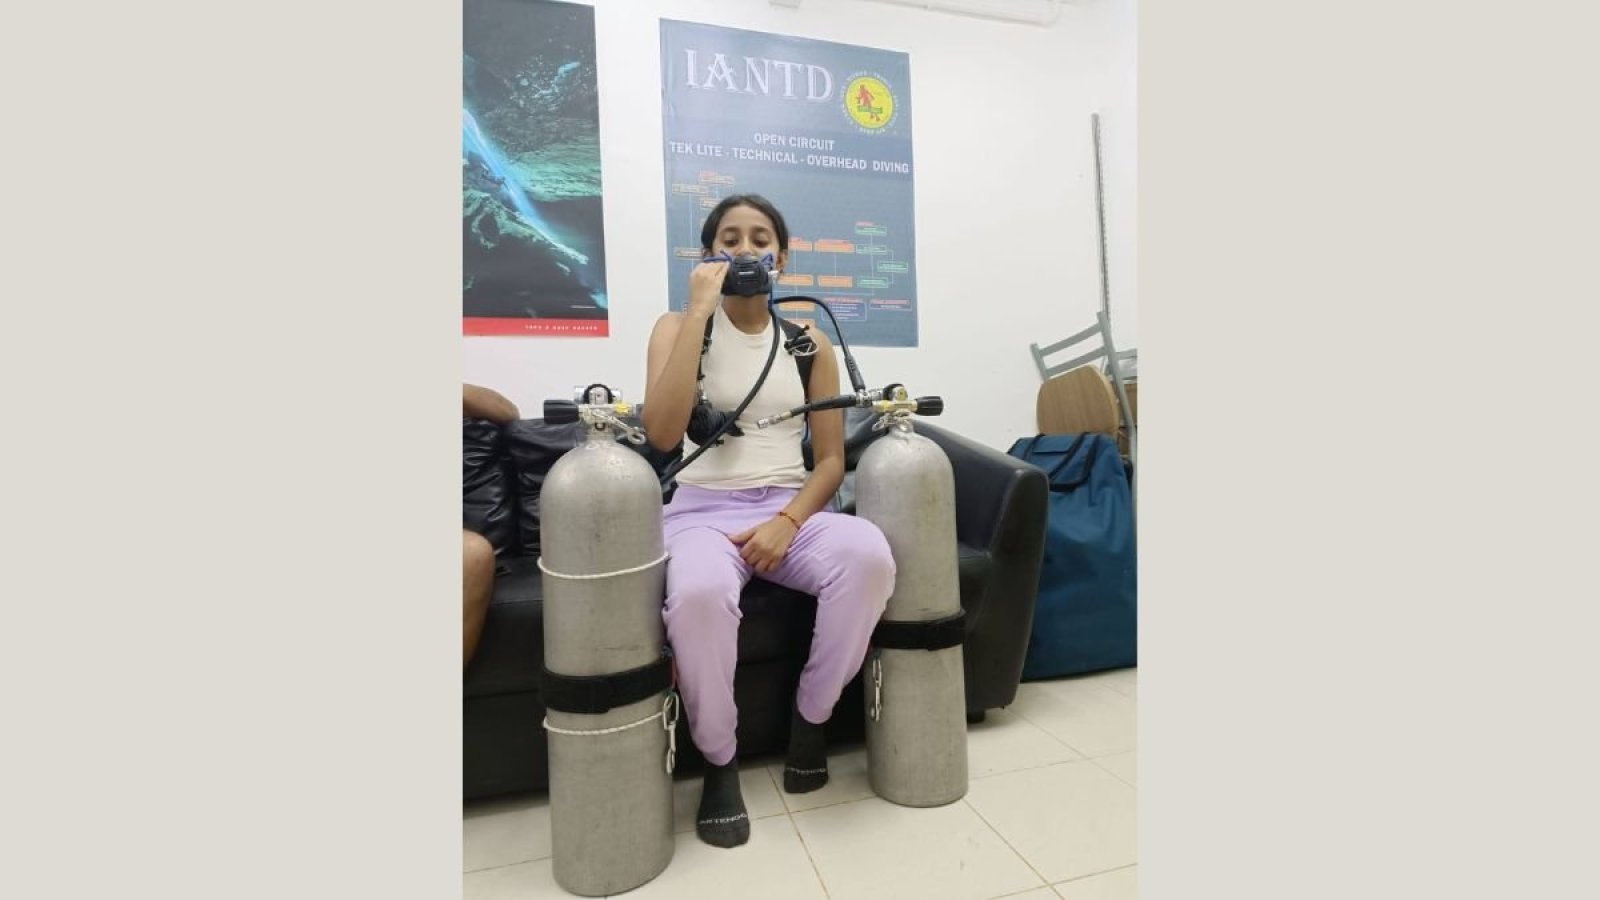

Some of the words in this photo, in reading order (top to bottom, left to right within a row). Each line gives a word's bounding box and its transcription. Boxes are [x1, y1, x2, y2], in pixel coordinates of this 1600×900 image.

[685, 48, 834, 102] IANTD
[669, 141, 694, 154] TEK
[696, 143, 723, 157] LITE
[731, 147, 798, 165] TECHNICAL
[807, 154, 867, 171] OVERHEAD
[872, 160, 909, 174] DIVING
[753, 132, 786, 146] OPEN
[788, 136, 836, 151] CIRCUIT
